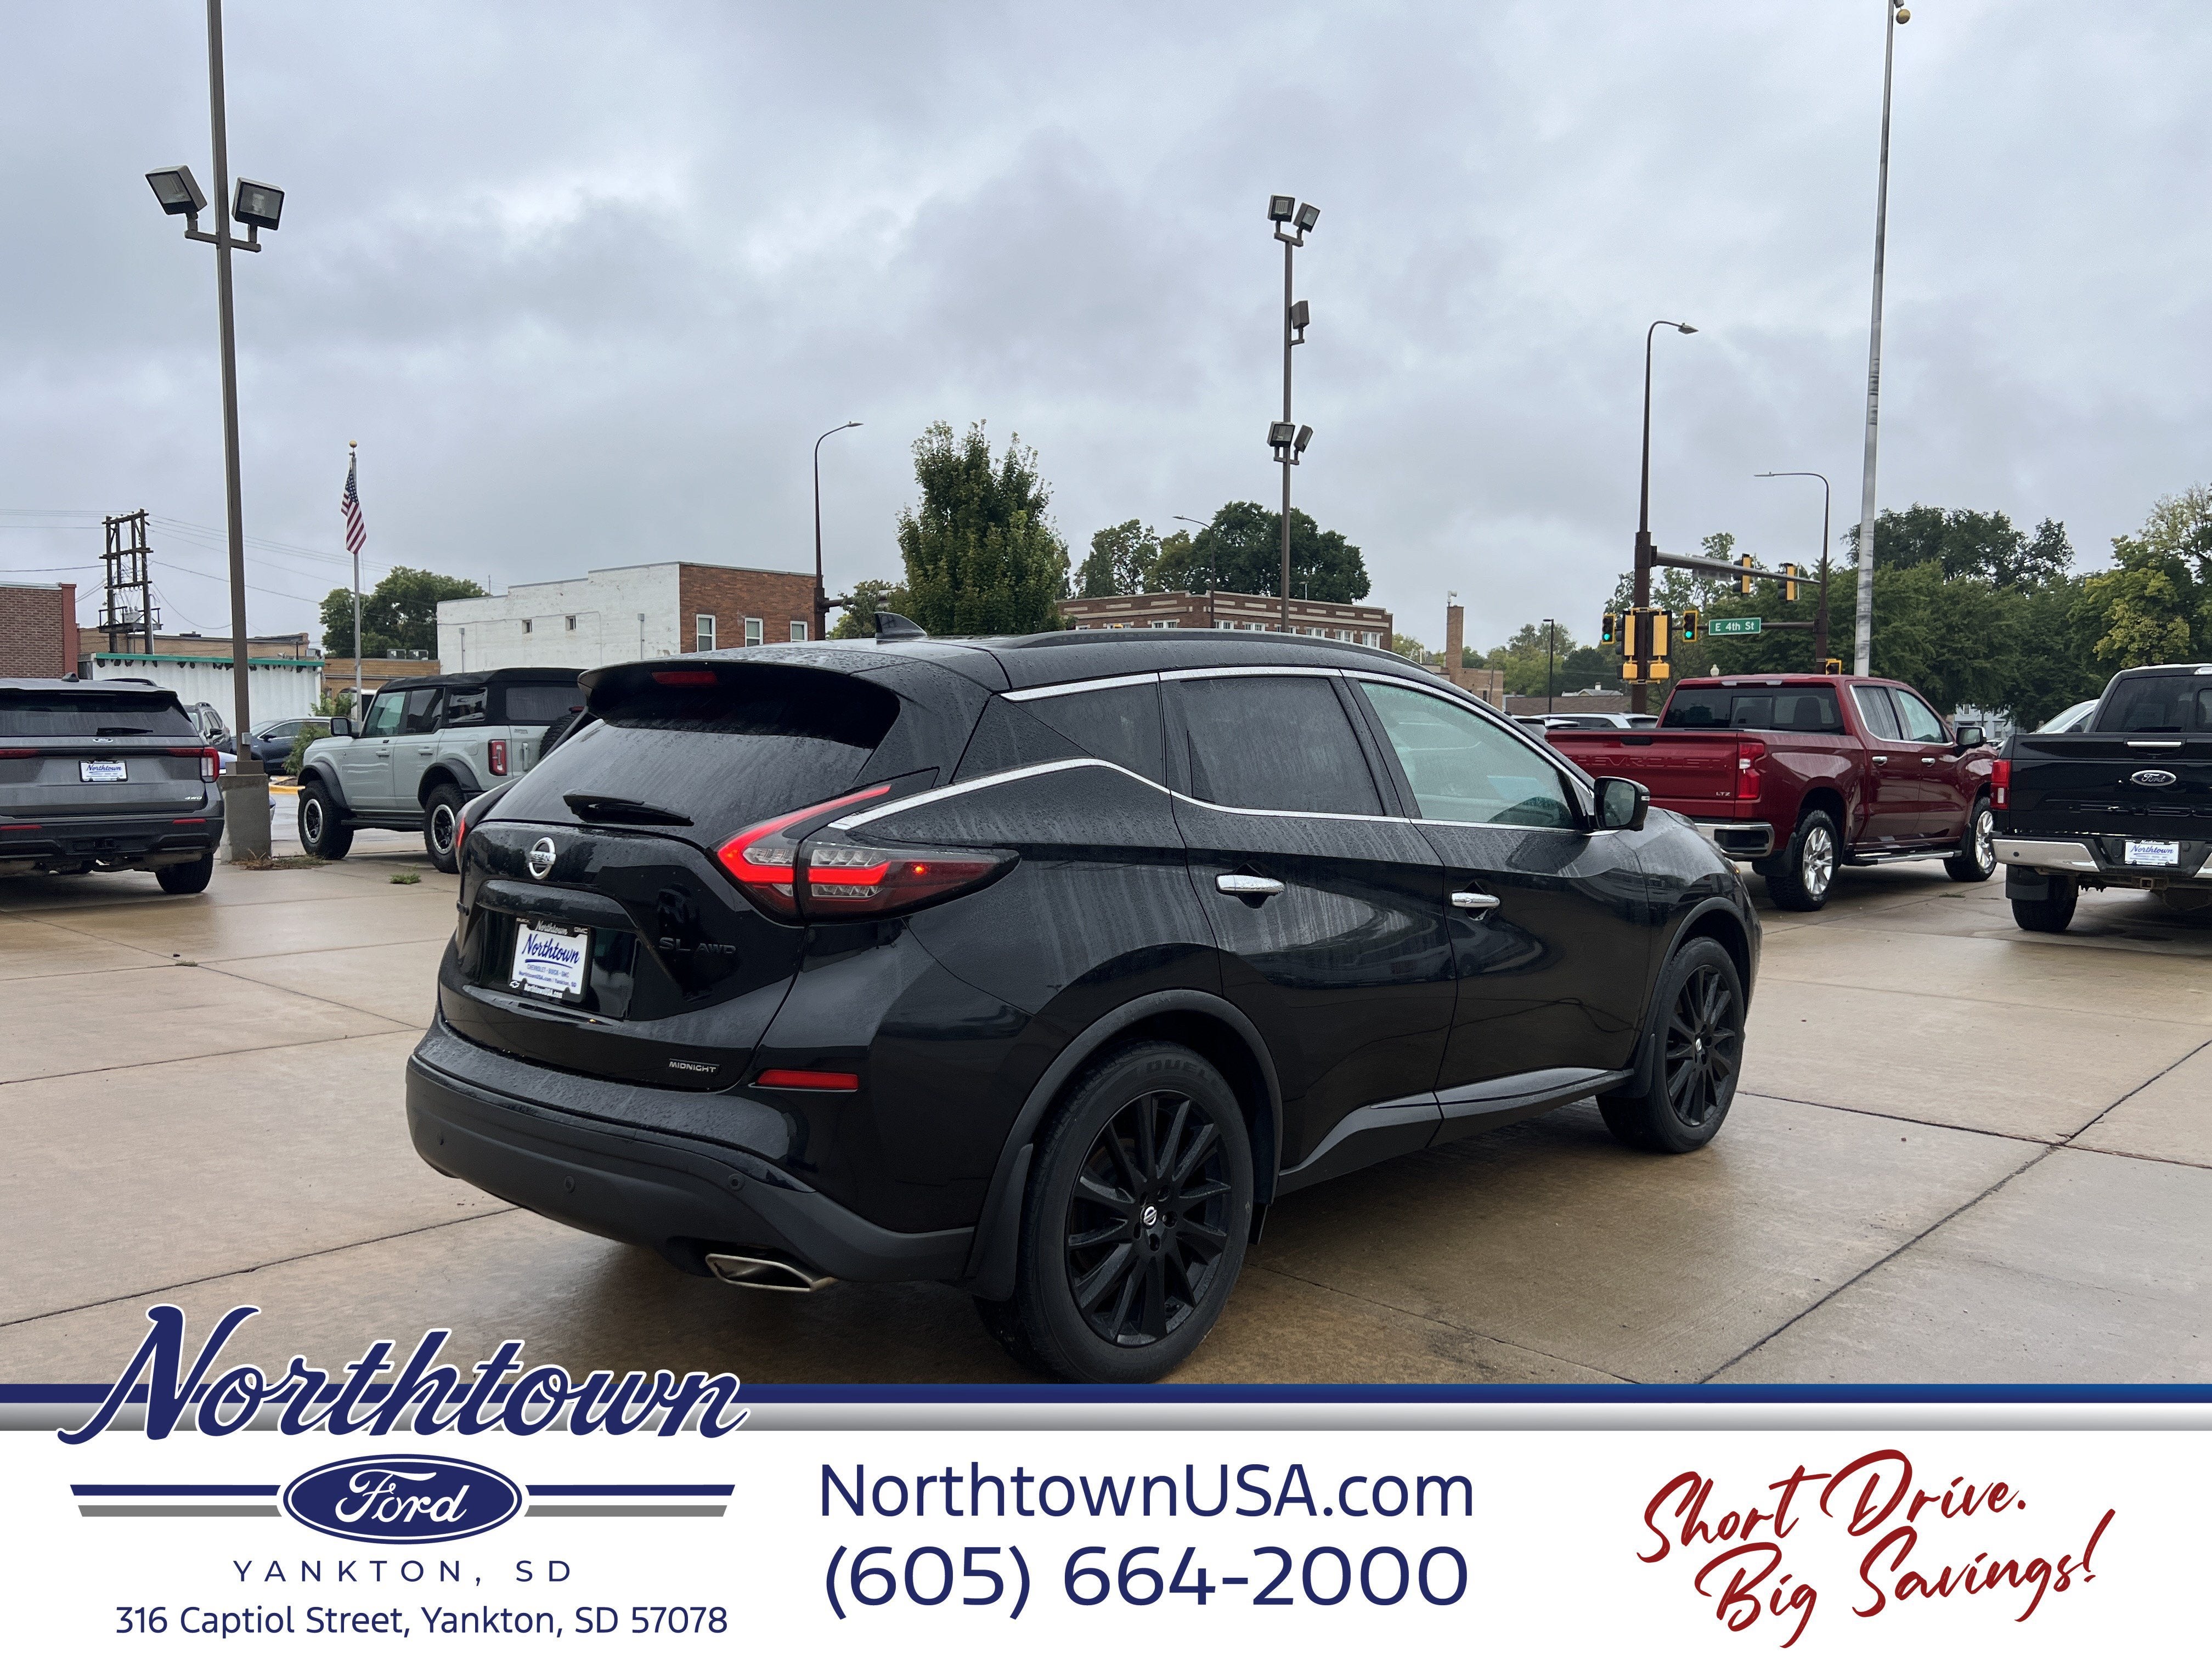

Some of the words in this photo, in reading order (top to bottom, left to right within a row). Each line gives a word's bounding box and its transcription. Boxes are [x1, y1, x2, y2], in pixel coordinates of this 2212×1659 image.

[1715, 623, 1721, 631] E
[1725, 622, 1741, 631] 4th
[1745, 621, 1754, 630] St
[2141, 773, 2166, 782] Ford
[2130, 845, 2174, 854] Northtown
[534, 920, 568, 935] Northtown
[522, 933, 580, 964] Northtown
[659, 937, 691, 951] SL
[696, 943, 736, 953] AWD
[669, 1061, 716, 1073] MIDNIGHT
